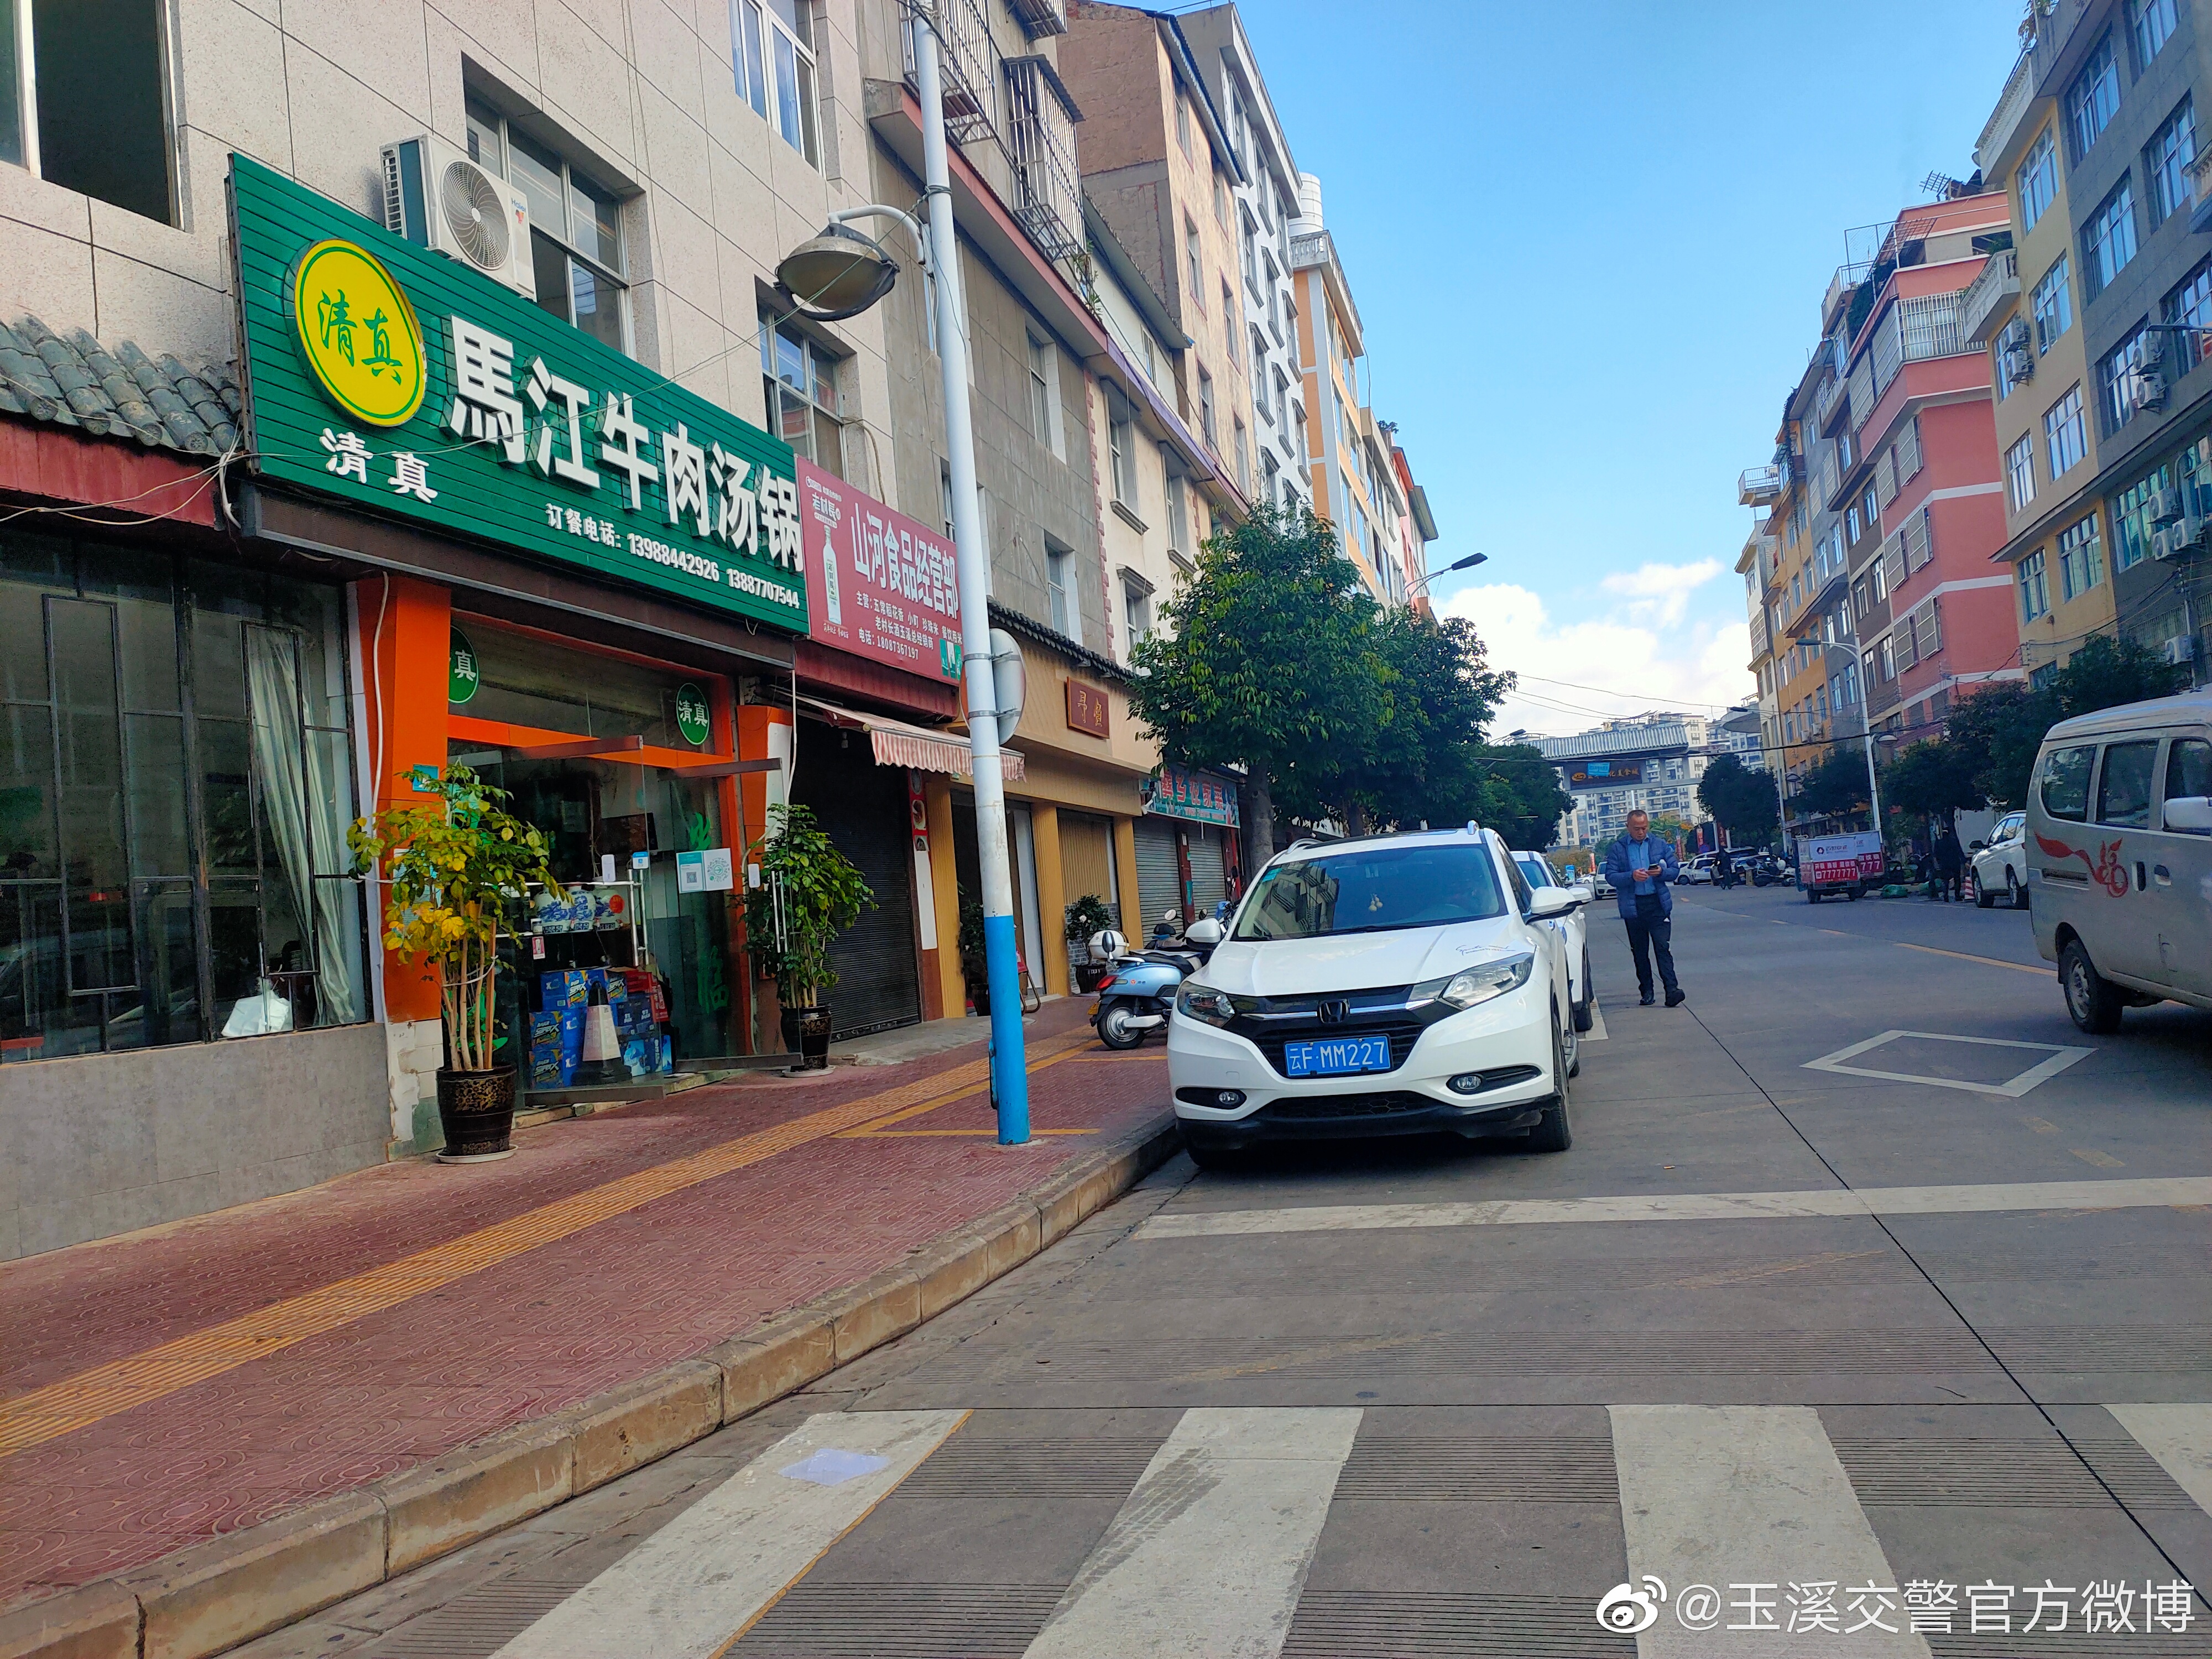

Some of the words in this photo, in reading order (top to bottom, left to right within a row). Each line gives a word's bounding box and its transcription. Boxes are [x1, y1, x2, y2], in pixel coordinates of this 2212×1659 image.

[511, 197, 526, 212] Haier
[317, 289, 403, 386] 清真
[319, 427, 439, 503] 清真
[450, 315, 804, 572] 馬江牛肉汤锅
[627, 533, 720, 582] 13988442926
[727, 568, 801, 609] 13887707544
[851, 502, 959, 620] 山河食品经营部
[449, 649, 479, 682] 真
[877, 635, 919, 660] 18087367197
[677, 700, 708, 727] 清真
